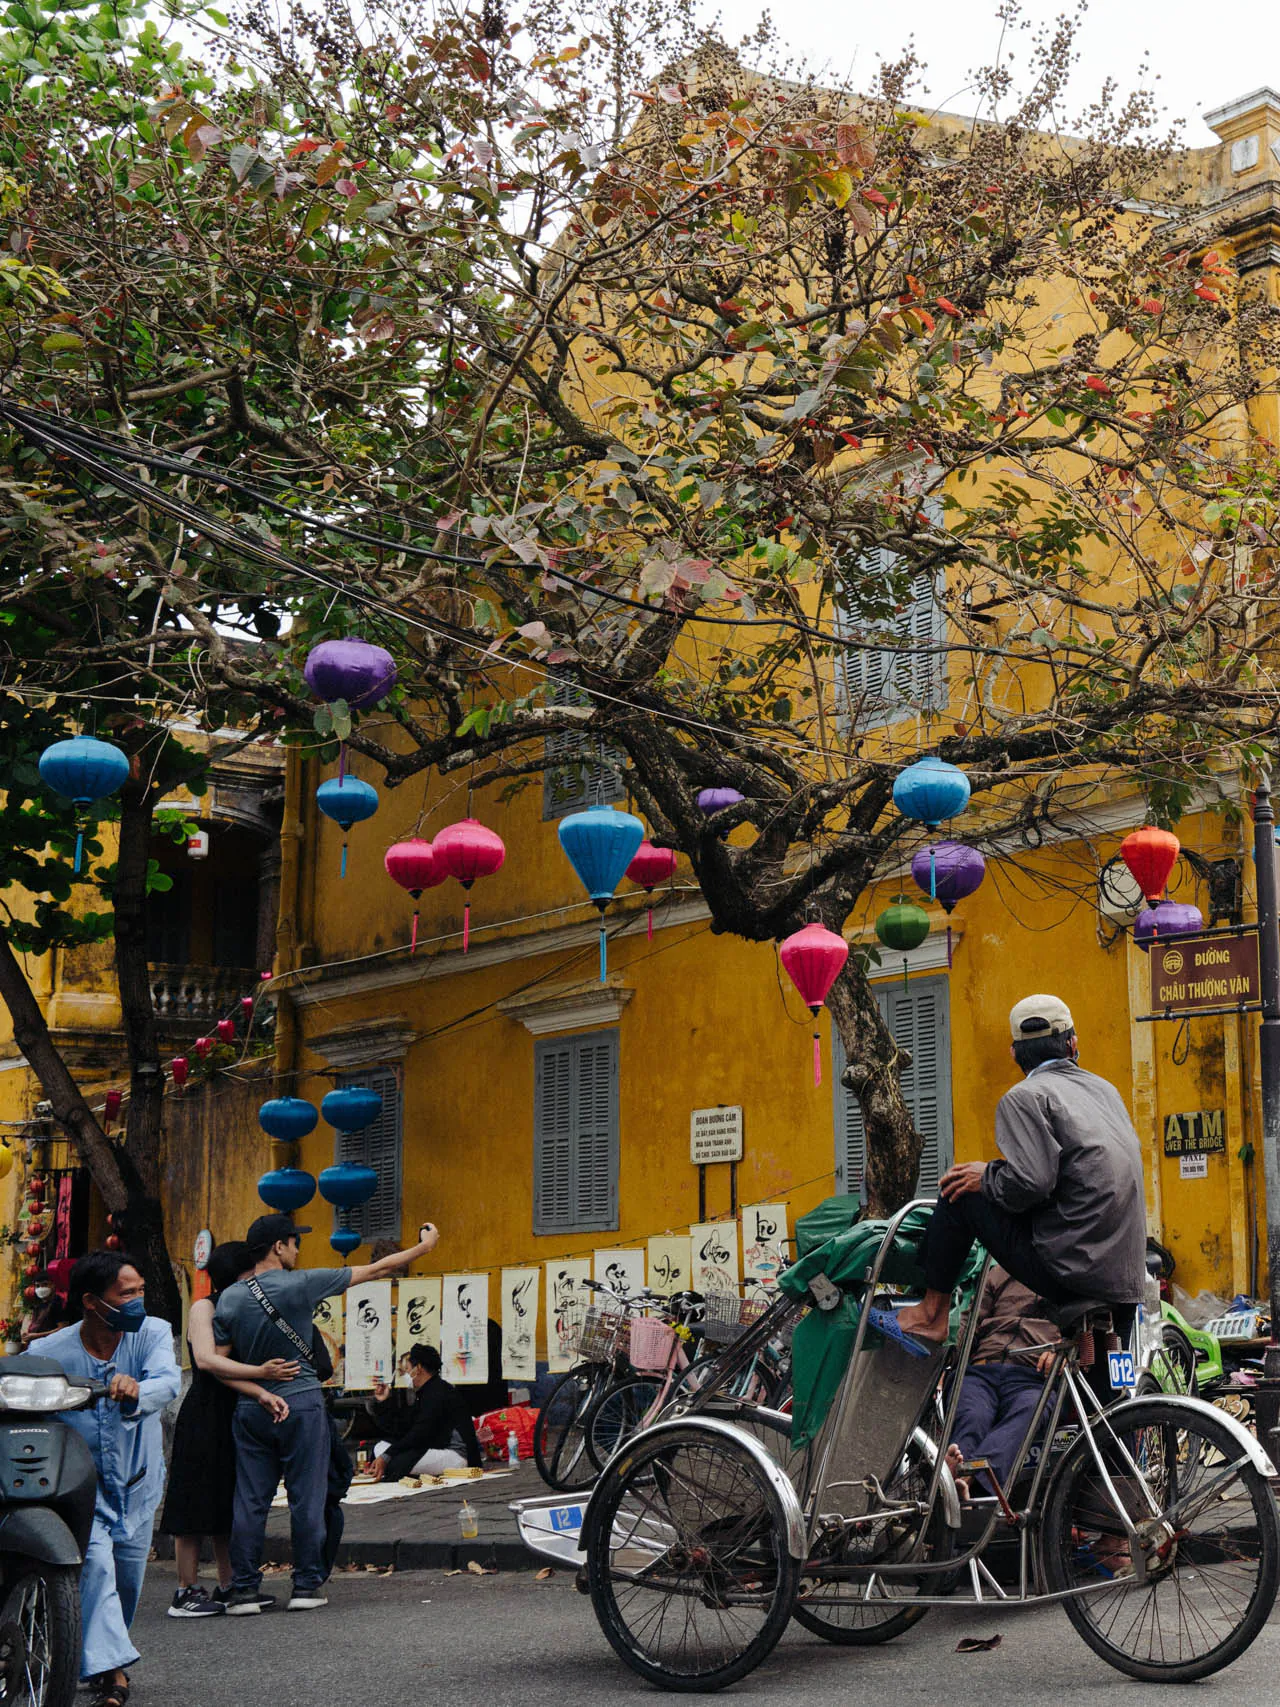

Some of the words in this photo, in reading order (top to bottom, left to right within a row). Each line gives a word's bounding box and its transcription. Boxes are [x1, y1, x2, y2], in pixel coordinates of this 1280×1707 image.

[1195, 946, 1230, 966] ĐƯỜNG
[1160, 981, 1185, 1002] CHÂU
[1188, 976, 1228, 1000] THƯỢNG
[1230, 974, 1250, 994] VĂN
[1166, 1110, 1222, 1140] ATM
[1165, 1140, 1182, 1152] OVER
[1185, 1139, 1197, 1150] THE
[1199, 1136, 1223, 1149] BRIDGE
[287, 1330, 312, 1356] HORSE
[1110, 1358, 1133, 1383] 012
[555, 1508, 572, 1528] 12
